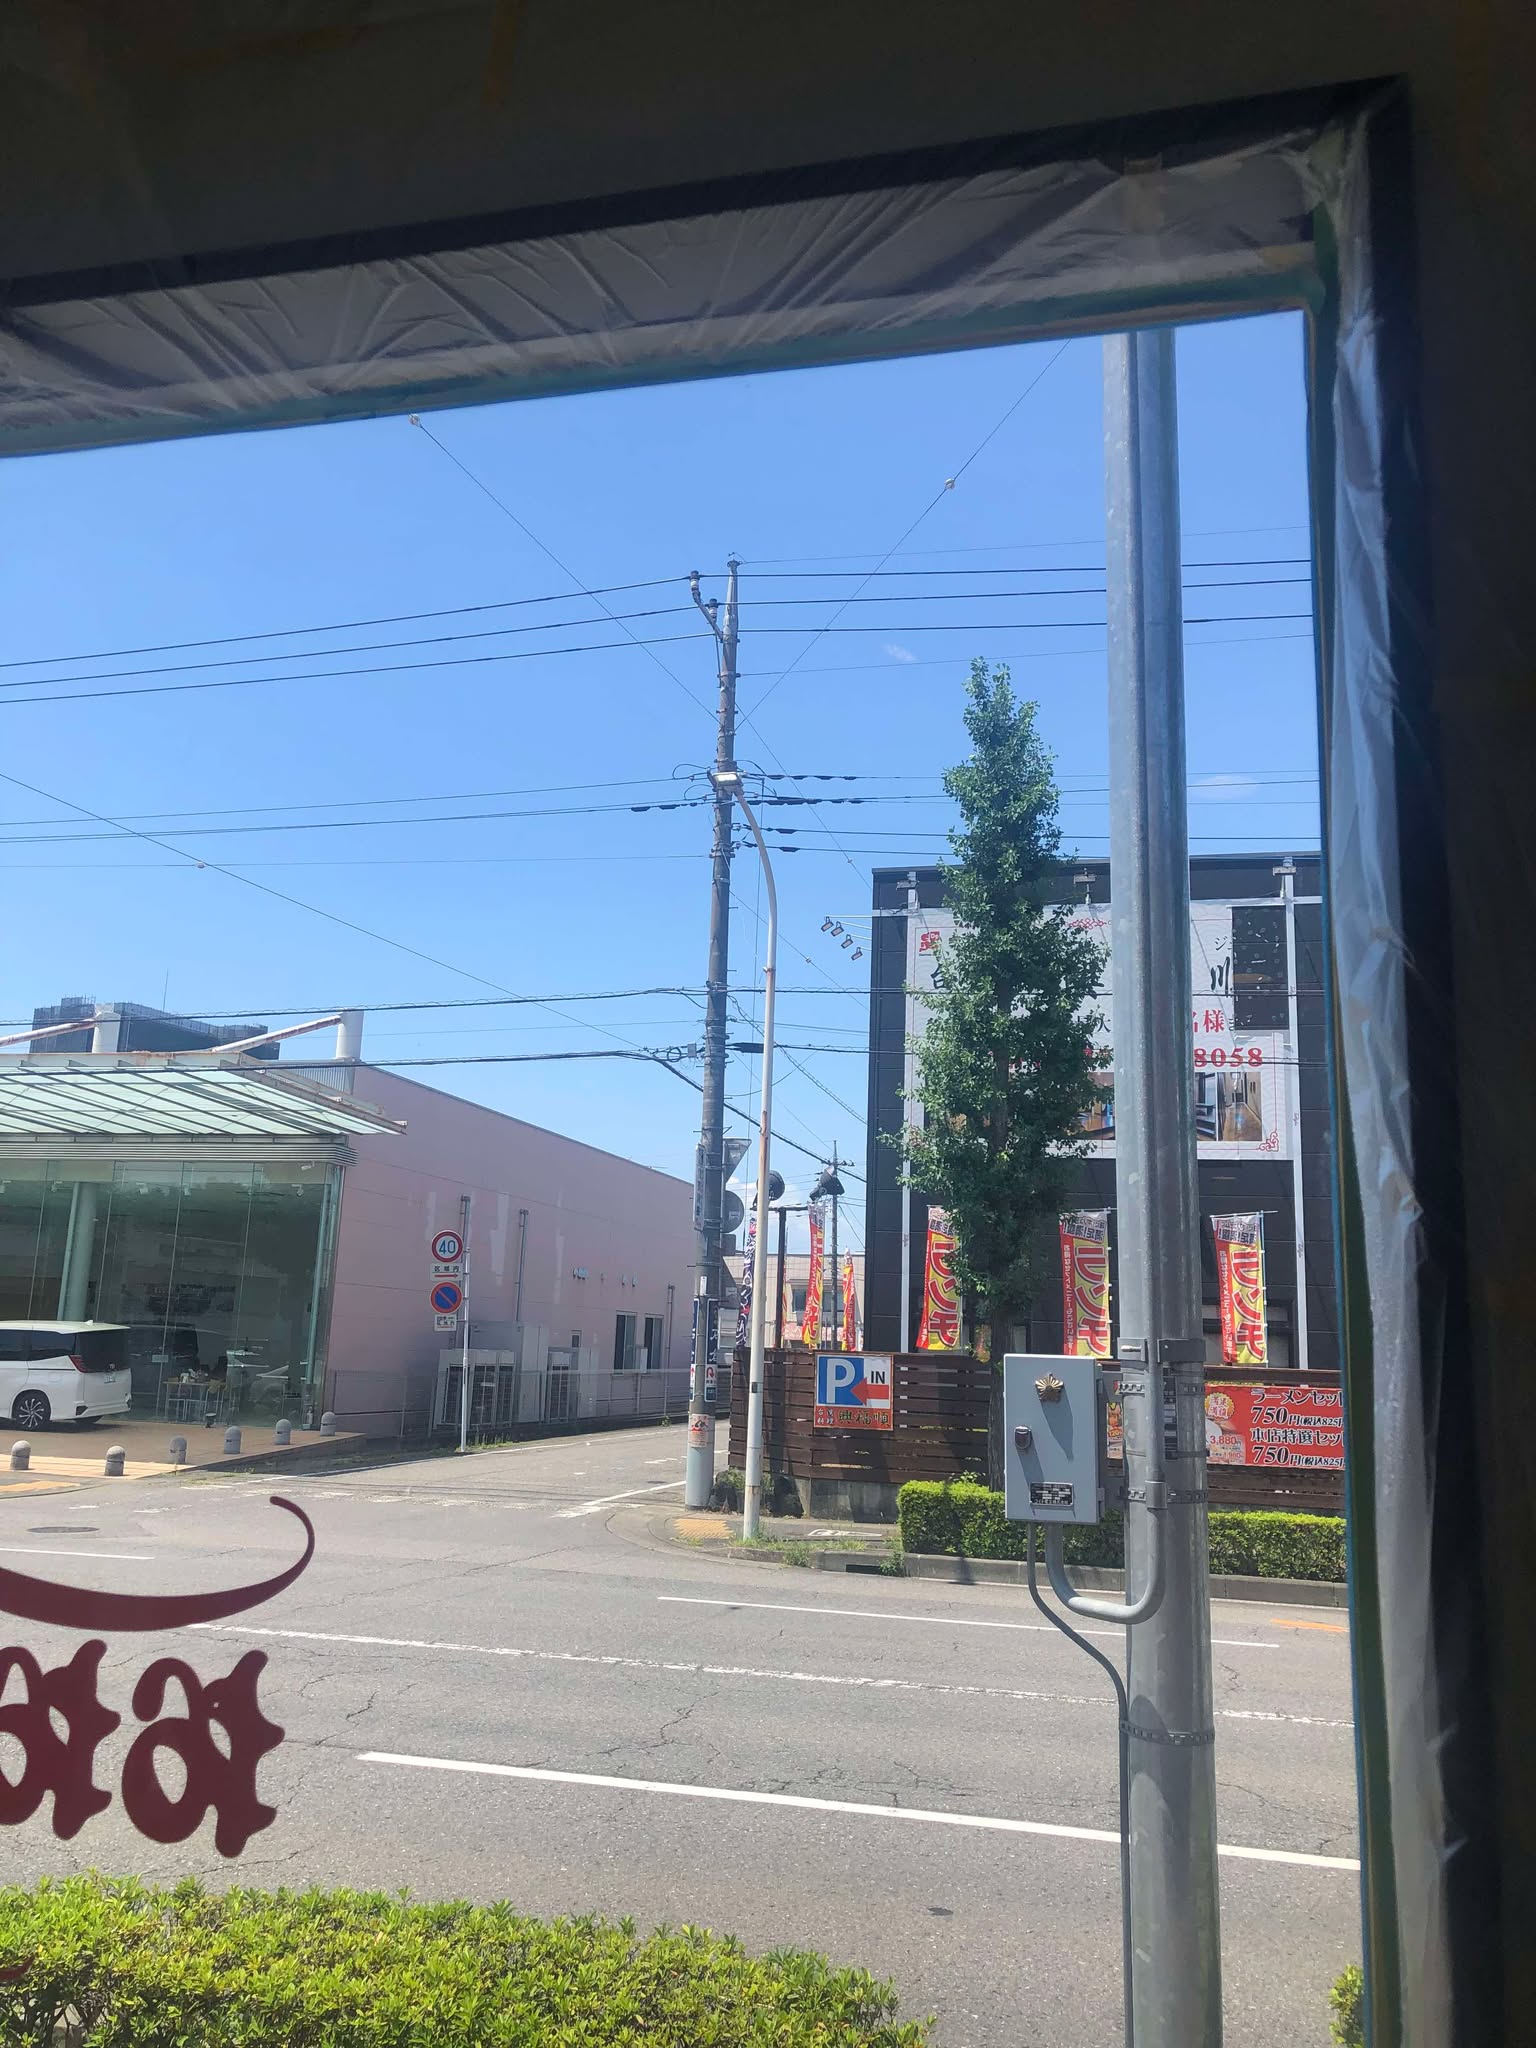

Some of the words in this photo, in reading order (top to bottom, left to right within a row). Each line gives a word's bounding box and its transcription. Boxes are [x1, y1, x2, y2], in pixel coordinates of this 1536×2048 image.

[439, 1240, 456, 1254] 40
[826, 1358, 856, 1403] P
[871, 1371, 885, 1384] IN
